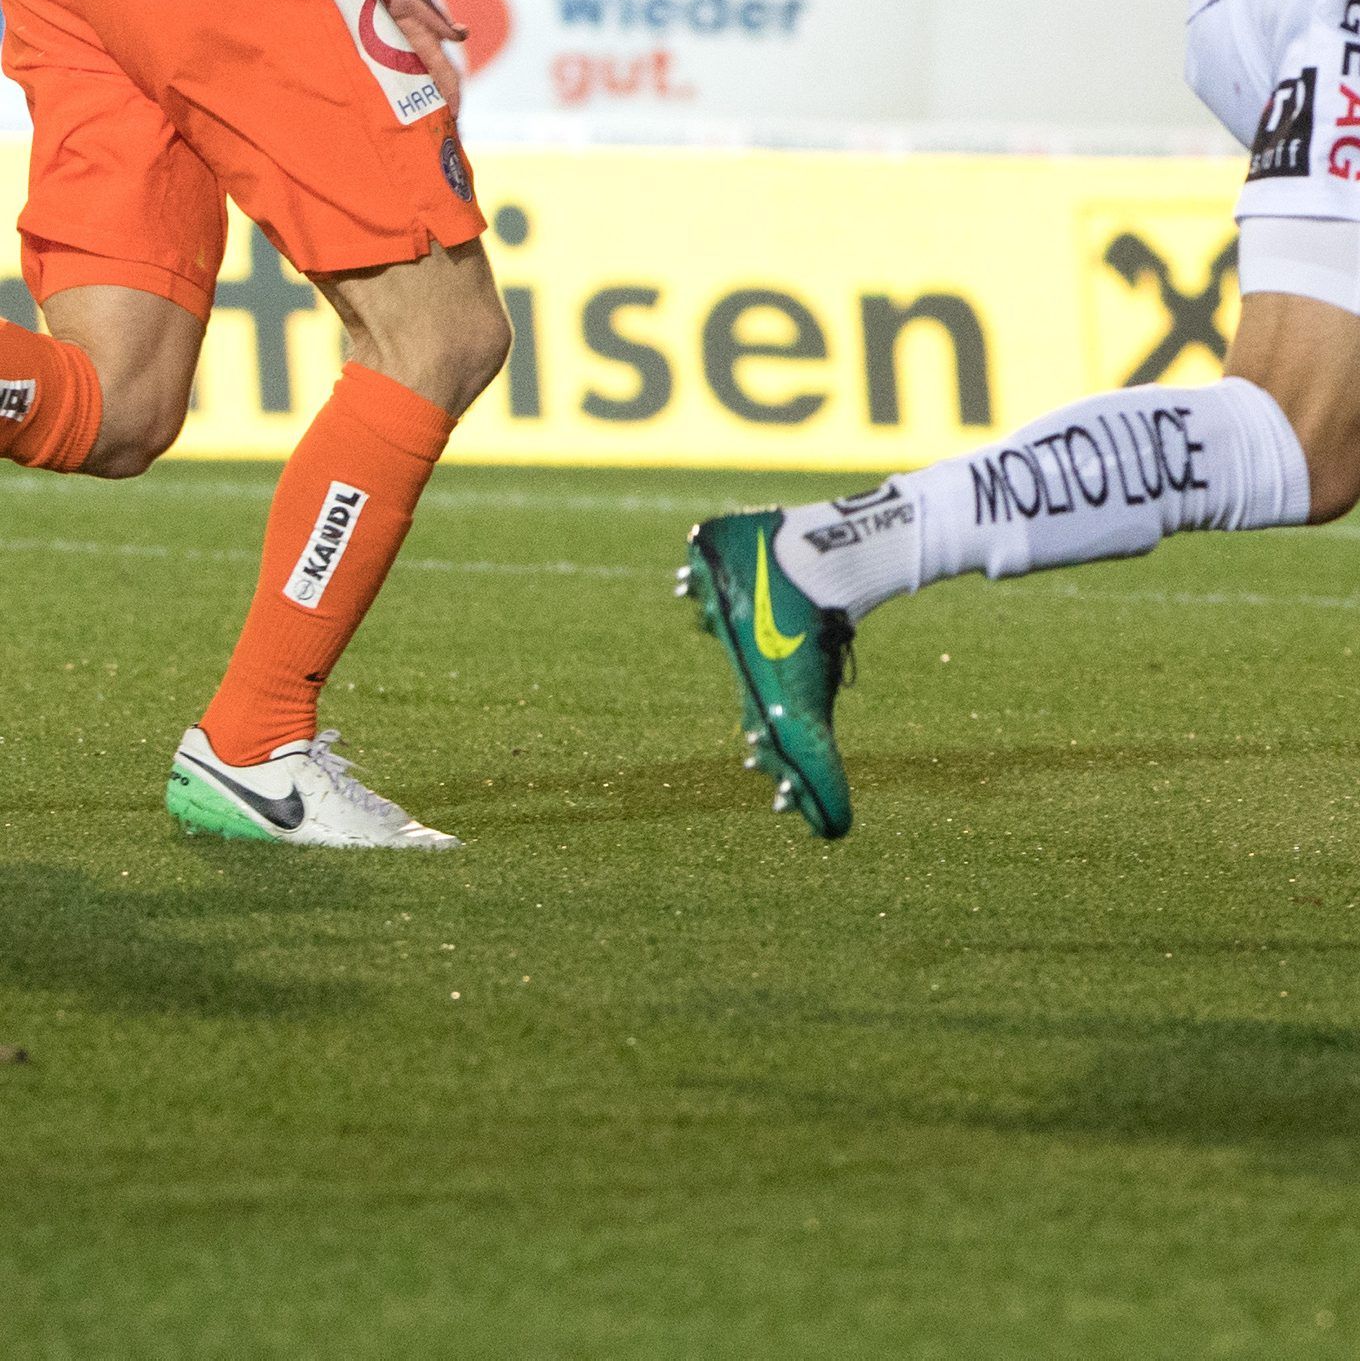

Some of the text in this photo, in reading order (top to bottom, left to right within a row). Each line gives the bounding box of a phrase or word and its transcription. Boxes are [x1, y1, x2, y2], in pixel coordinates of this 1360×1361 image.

[397, 81, 444, 117] HAR
[551, 42, 698, 107] gut.
[970, 406, 1209, 525] MOLTO LUCE
[303, 492, 361, 581] KANDL
